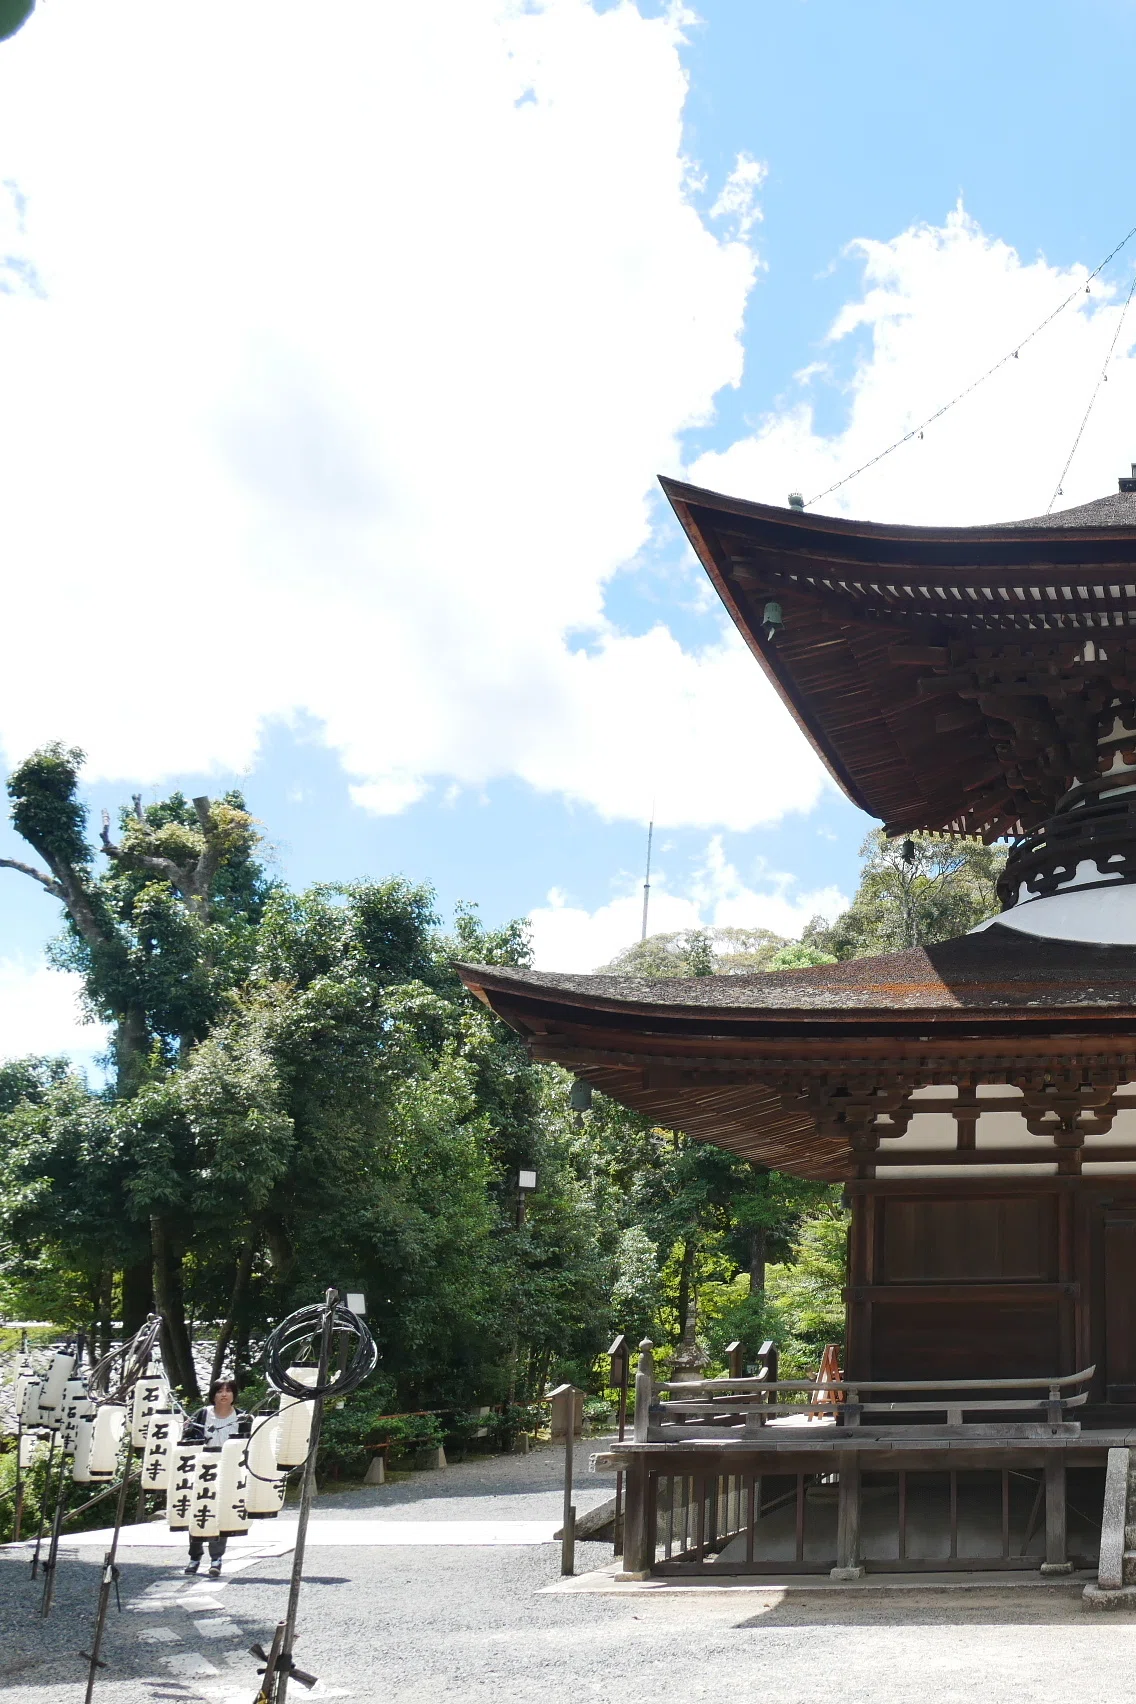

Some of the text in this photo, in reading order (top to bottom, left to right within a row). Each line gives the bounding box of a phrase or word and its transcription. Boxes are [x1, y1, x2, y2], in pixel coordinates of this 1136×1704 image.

[146, 1423, 169, 1481] 石山寺
[172, 1455, 196, 1518] 石山寺
[194, 1463, 218, 1529] 石山寺
